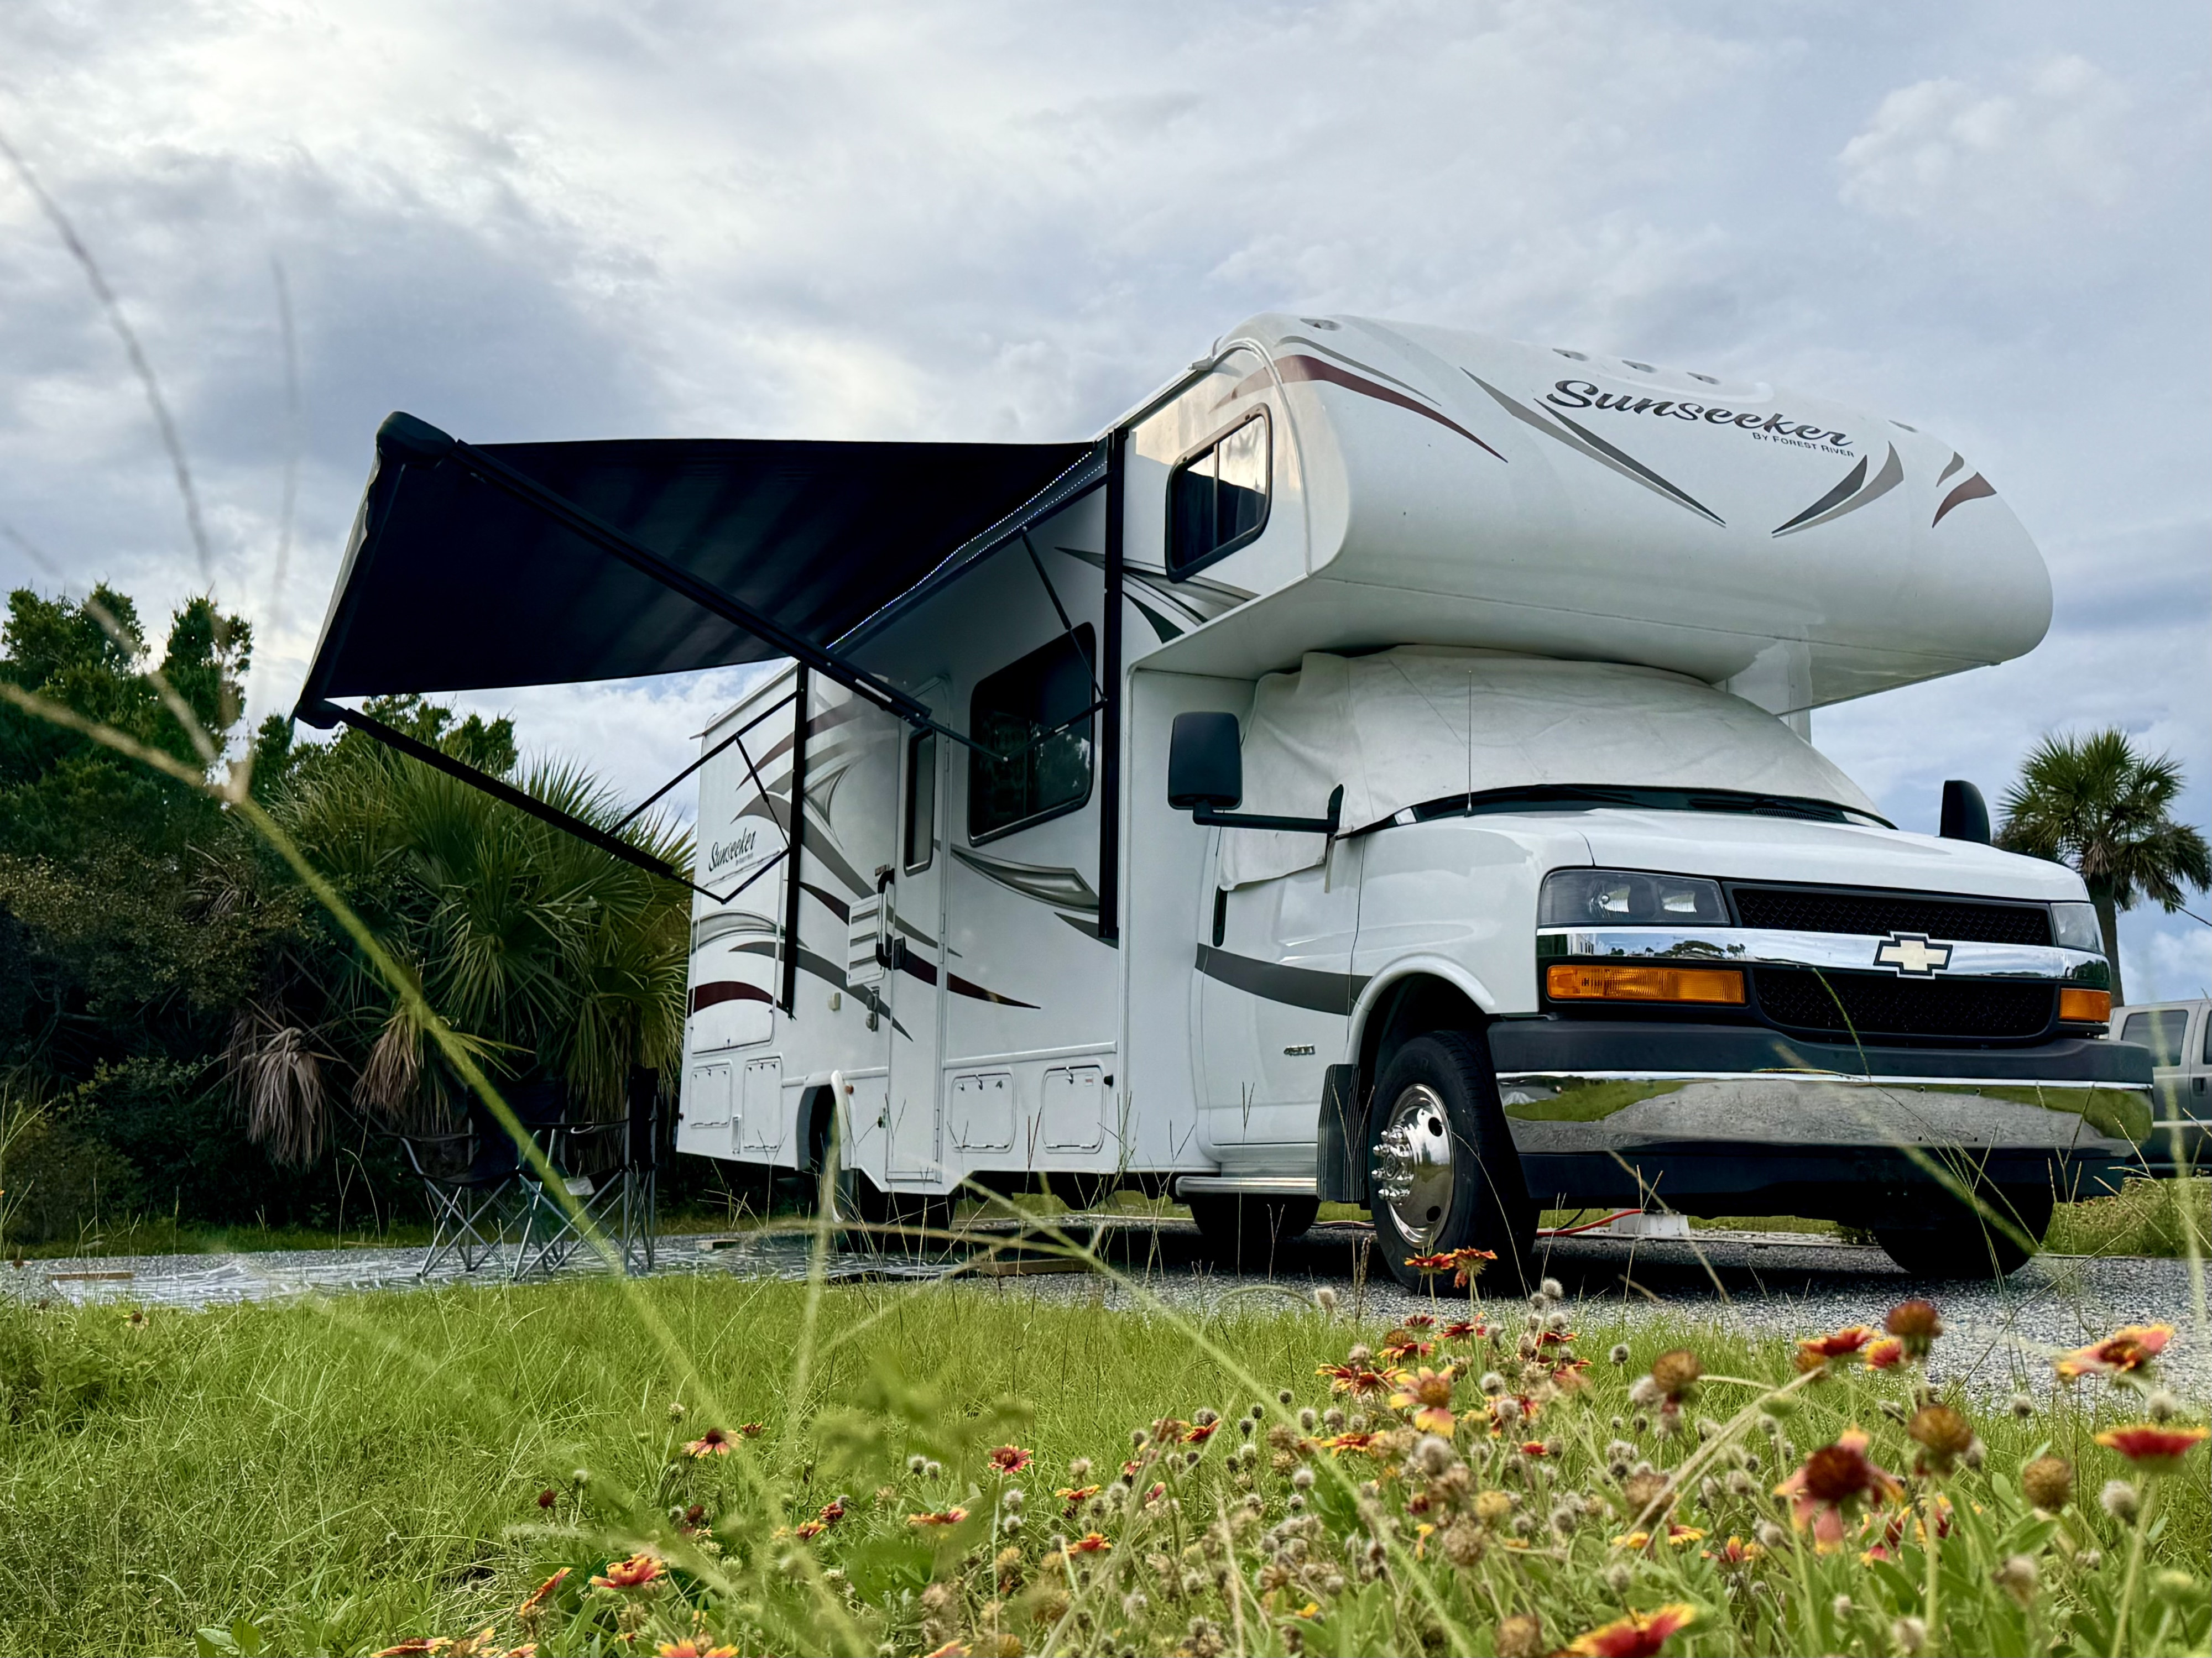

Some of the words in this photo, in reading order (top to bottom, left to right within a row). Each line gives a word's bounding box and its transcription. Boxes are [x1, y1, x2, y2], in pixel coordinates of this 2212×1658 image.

[1546, 380, 1854, 446] Sunseeker
[1752, 432, 1768, 441] BY
[1772, 436, 1817, 449] FOREST
[1820, 444, 1855, 458] RIVER
[708, 827, 757, 872] Sunseeker
